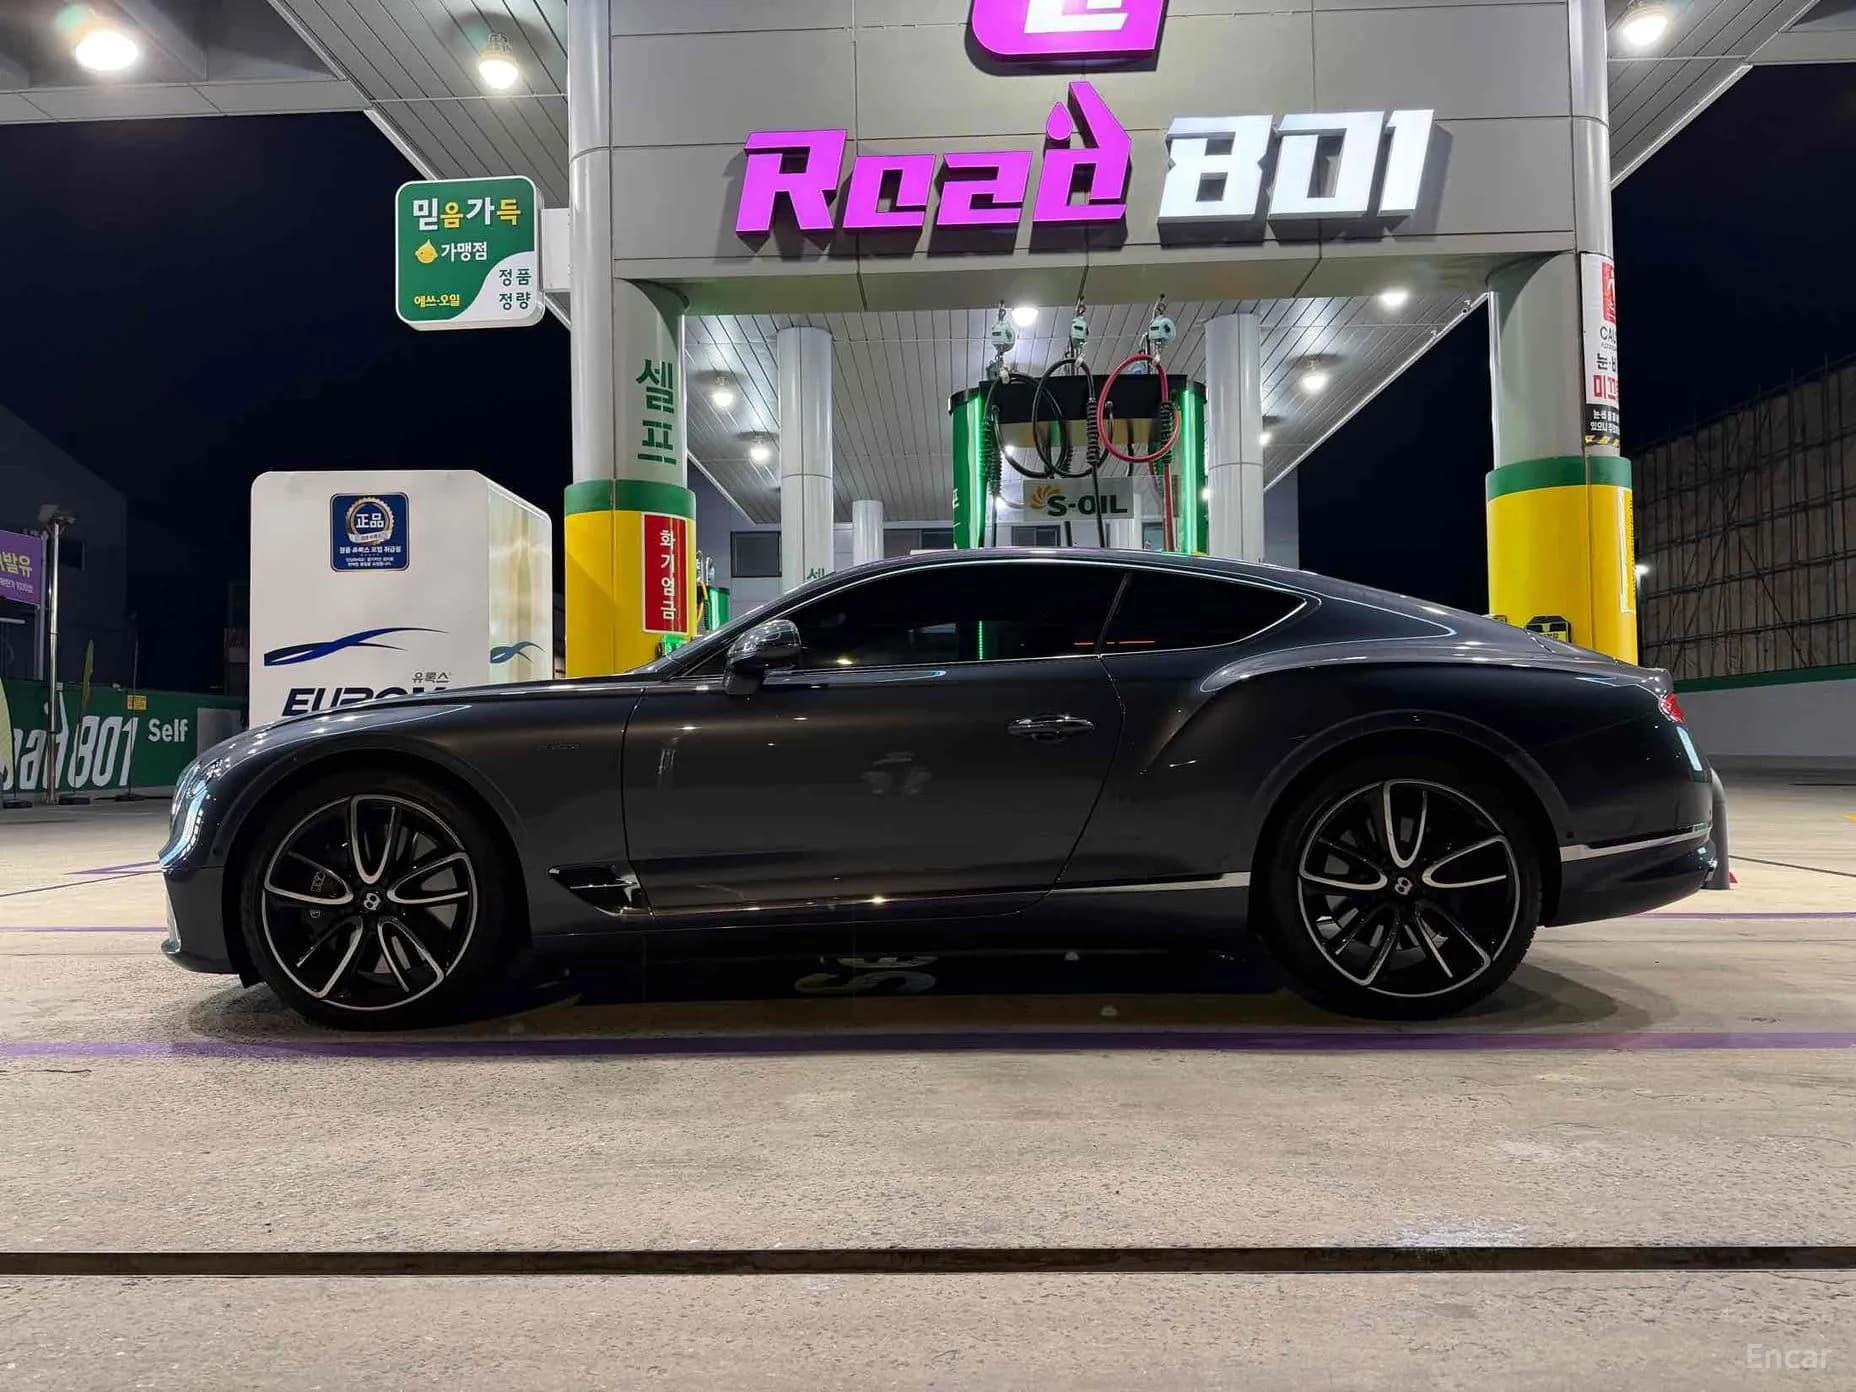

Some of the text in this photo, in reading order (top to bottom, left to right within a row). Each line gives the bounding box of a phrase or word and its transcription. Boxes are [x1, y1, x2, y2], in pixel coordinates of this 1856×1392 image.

[1156, 109, 1434, 224] 801
[413, 197, 521, 231] 믿음가득
[441, 241, 488, 262] 가맹점
[636, 359, 678, 465] 셀프
[1047, 494, 1128, 516] S-OIL
[355, 512, 385, 528] 正品
[0, 551, 33, 578] 발유
[660, 529, 676, 620] 화기엄금
[411, 672, 449, 684] 유록스
[147, 718, 188, 742] Self
